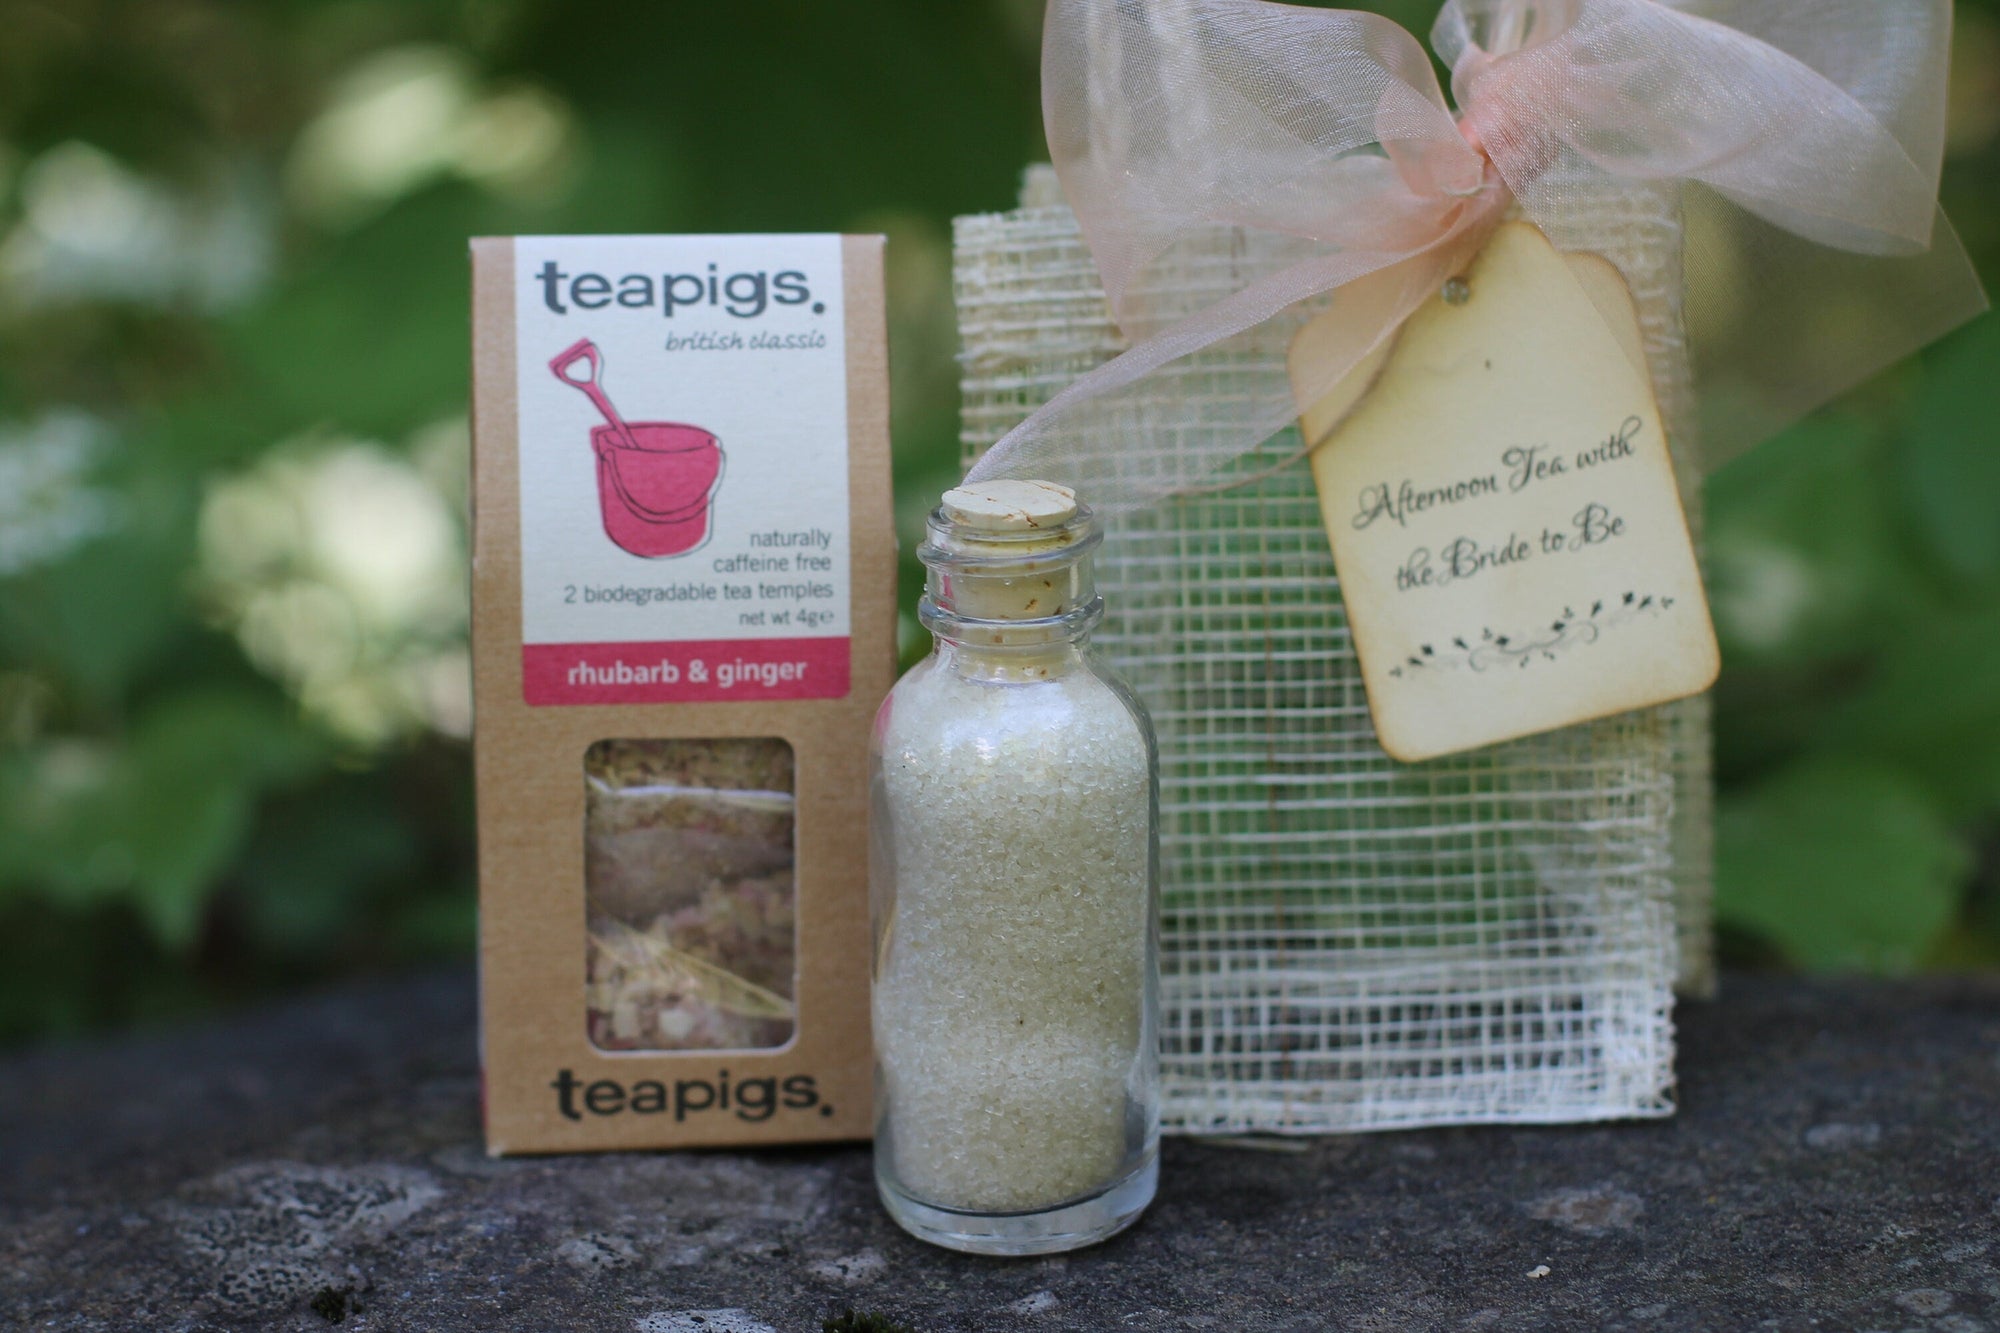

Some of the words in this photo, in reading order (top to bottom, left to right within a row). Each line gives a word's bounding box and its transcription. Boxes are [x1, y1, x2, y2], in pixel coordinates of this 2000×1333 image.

[535, 260, 826, 319] teapigs.
[665, 331, 743, 351] british
[750, 330, 826, 350] classic
[1351, 474, 1500, 530] Afternoon
[1501, 442, 1568, 492] Tea
[1576, 415, 1643, 470] with
[750, 529, 831, 551] naturally
[1395, 546, 1434, 592] the
[1436, 533, 1532, 586] Bride
[1541, 527, 1564, 553] to
[1568, 503, 1627, 552] Be
[713, 556, 789, 573] caffeine
[796, 554, 832, 572] free
[564, 586, 577, 603] 2
[585, 584, 717, 606] biodegradable
[723, 585, 751, 600] tea
[759, 581, 834, 603] temples
[739, 610, 765, 626] net
[771, 610, 790, 625] wt
[568, 660, 680, 686] rhubarb
[688, 659, 708, 683] &
[716, 658, 807, 688] ginger
[550, 1068, 835, 1122] teapigs.
